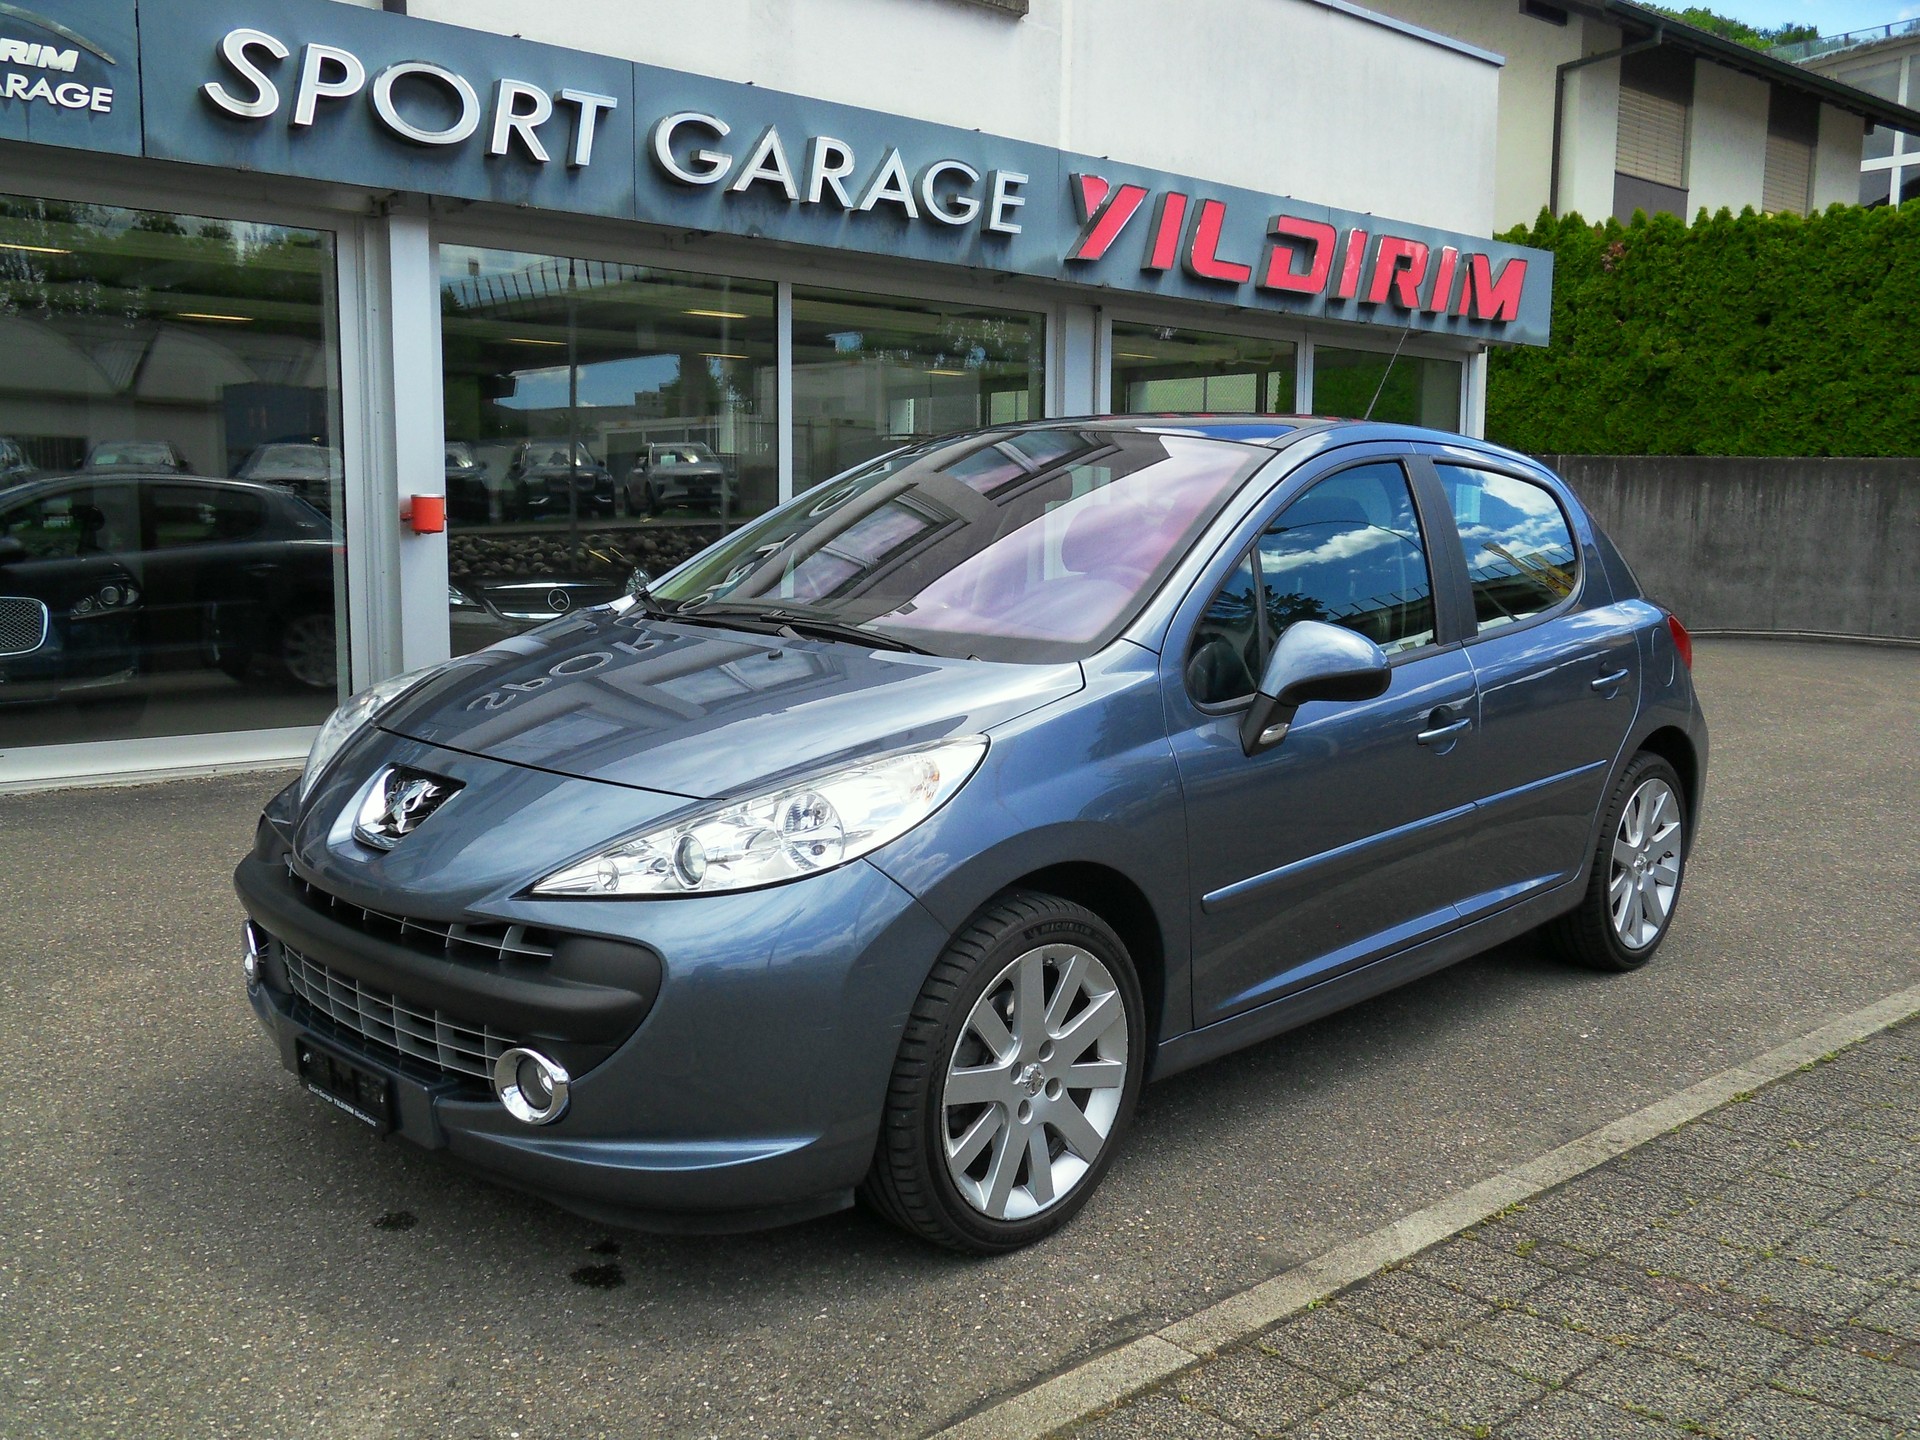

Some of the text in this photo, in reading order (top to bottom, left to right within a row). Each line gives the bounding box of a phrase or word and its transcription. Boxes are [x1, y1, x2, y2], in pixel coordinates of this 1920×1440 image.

[200, 28, 1528, 322] SPORT GARAGE YILDIRIM
[1039, 920, 1094, 936] MICHELIN
